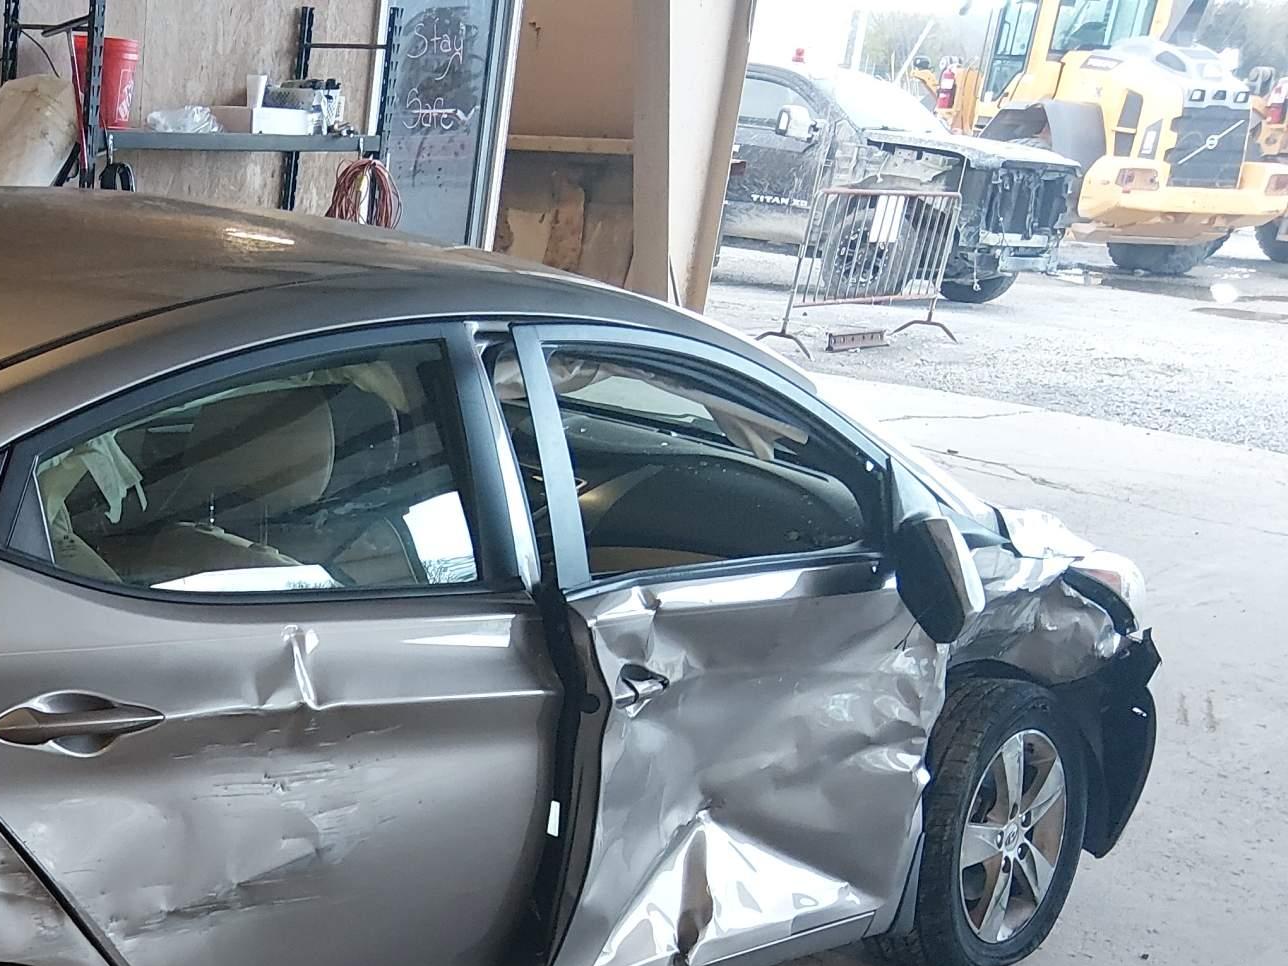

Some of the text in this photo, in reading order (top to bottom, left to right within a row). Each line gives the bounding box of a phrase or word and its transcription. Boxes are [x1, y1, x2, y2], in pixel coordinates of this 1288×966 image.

[407, 18, 465, 81] Stay
[402, 88, 455, 129] Safe
[751, 194, 790, 205] TITAN
